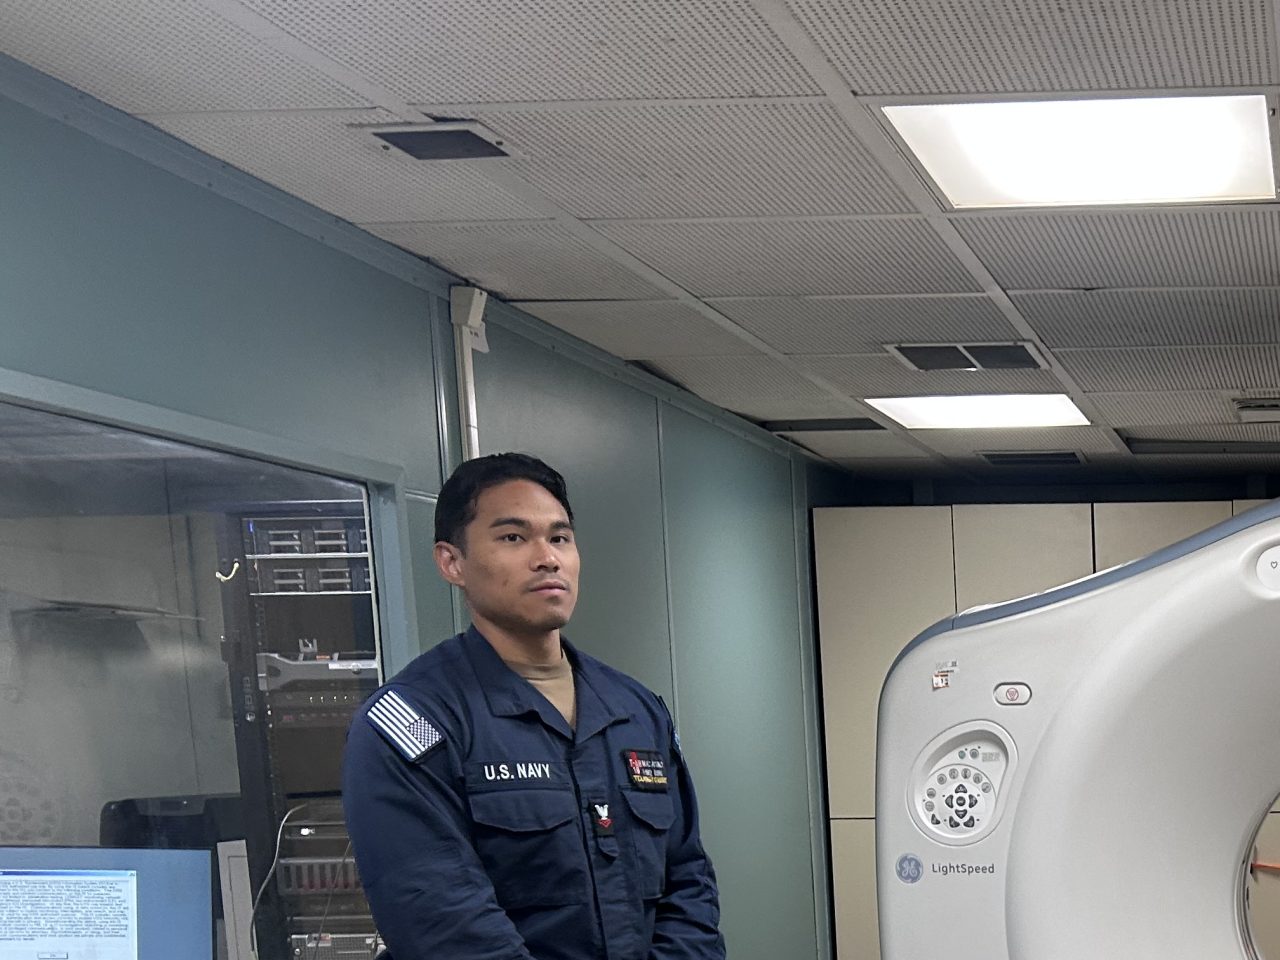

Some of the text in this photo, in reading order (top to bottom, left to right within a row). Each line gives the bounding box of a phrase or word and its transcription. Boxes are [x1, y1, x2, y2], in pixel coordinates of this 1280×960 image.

[484, 763, 550, 780] U.S. NAVY
[931, 863, 995, 876] LightSpeed
